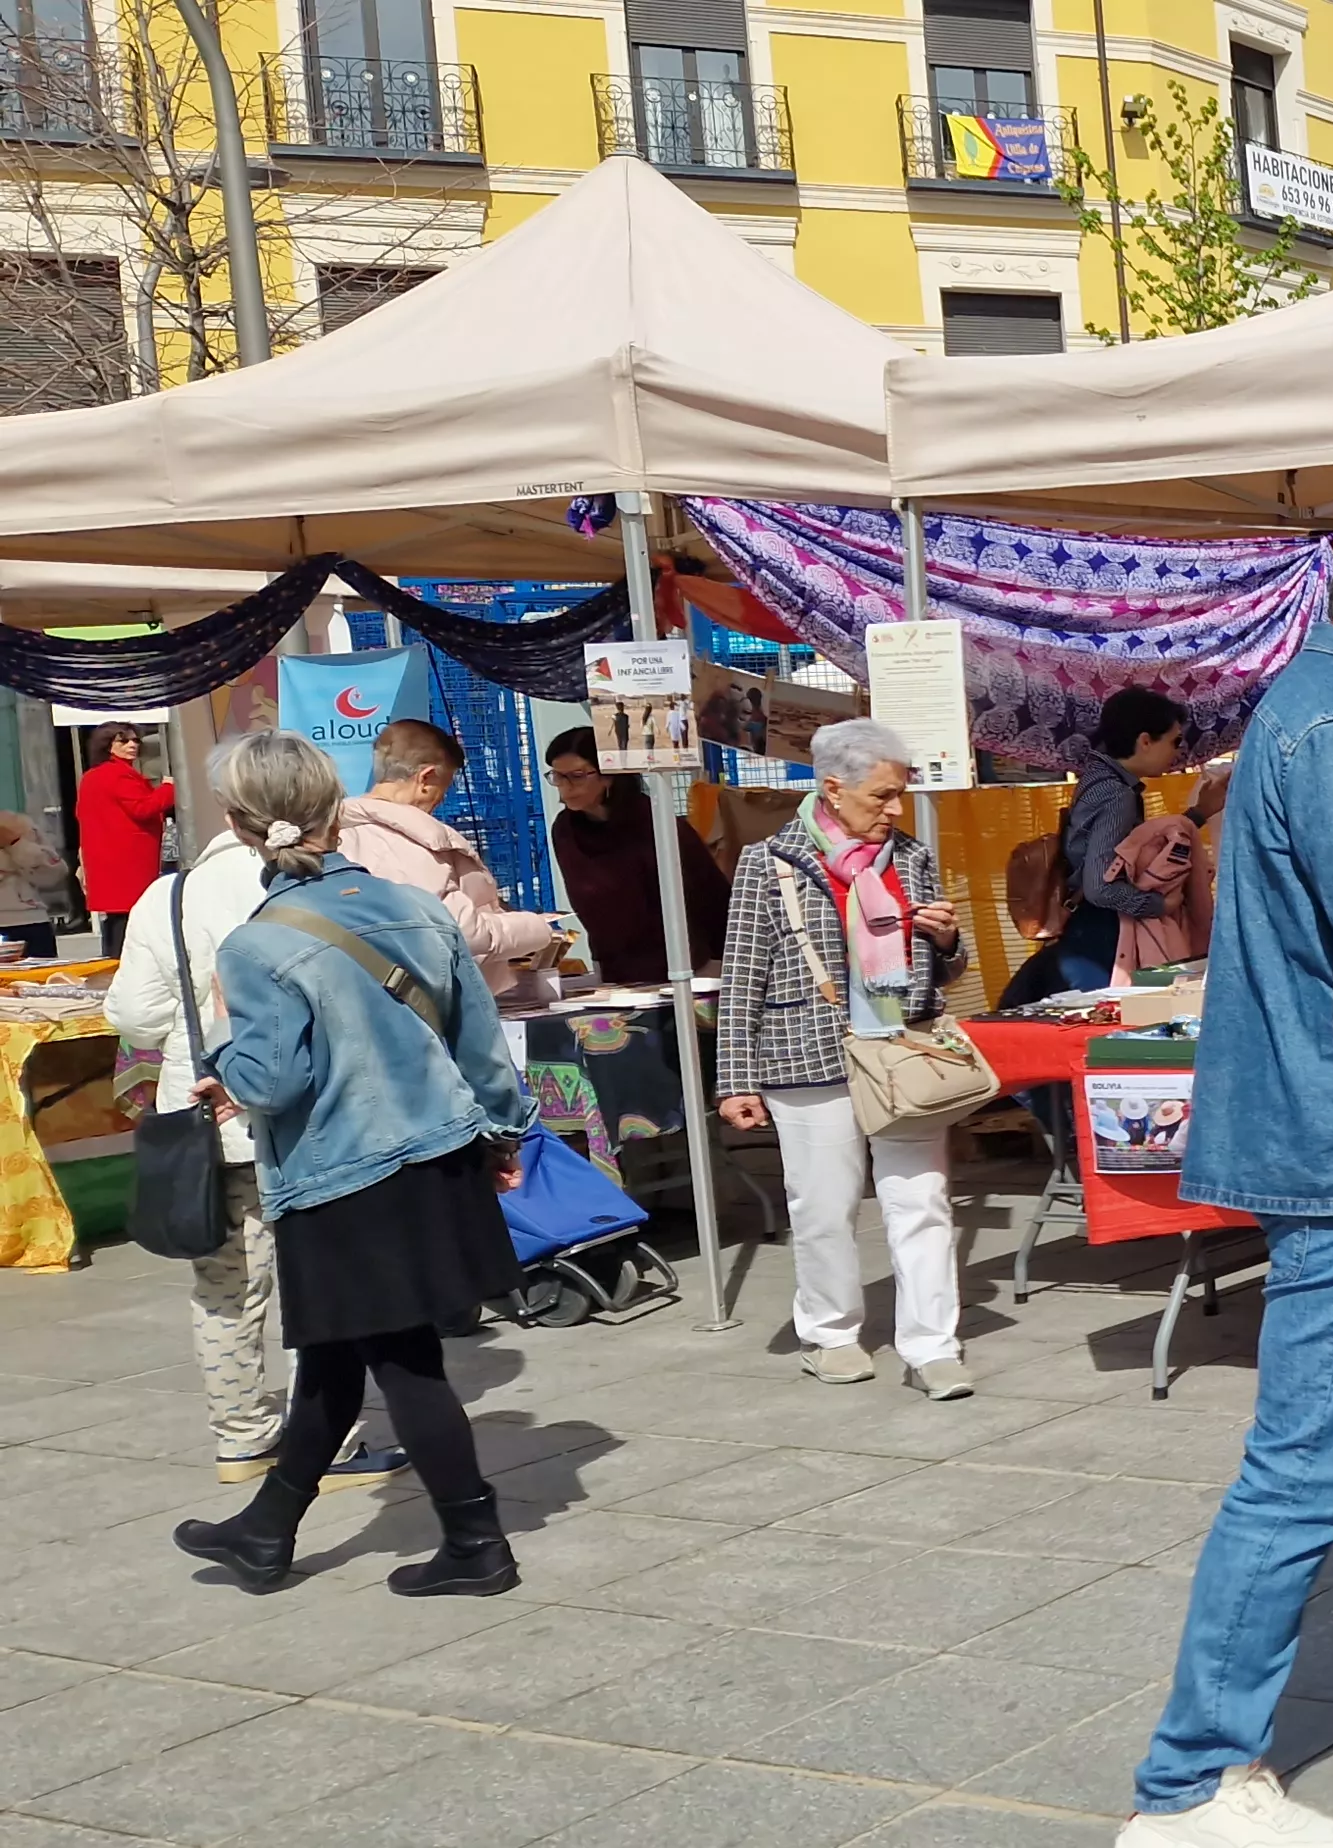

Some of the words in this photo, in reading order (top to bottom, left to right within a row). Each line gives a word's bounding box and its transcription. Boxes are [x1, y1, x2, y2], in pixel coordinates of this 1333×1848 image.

[1281, 184, 1300, 205] 653
[1302, 190, 1316, 210] 96
[1318, 194, 1331, 214] 96
[516, 481, 584, 497] MASTERTENT
[631, 656, 648, 666] POR
[648, 656, 664, 665] UNA
[617, 668, 657, 677] INFANCIA
[1091, 1082, 1122, 1090] BOLIVIA
